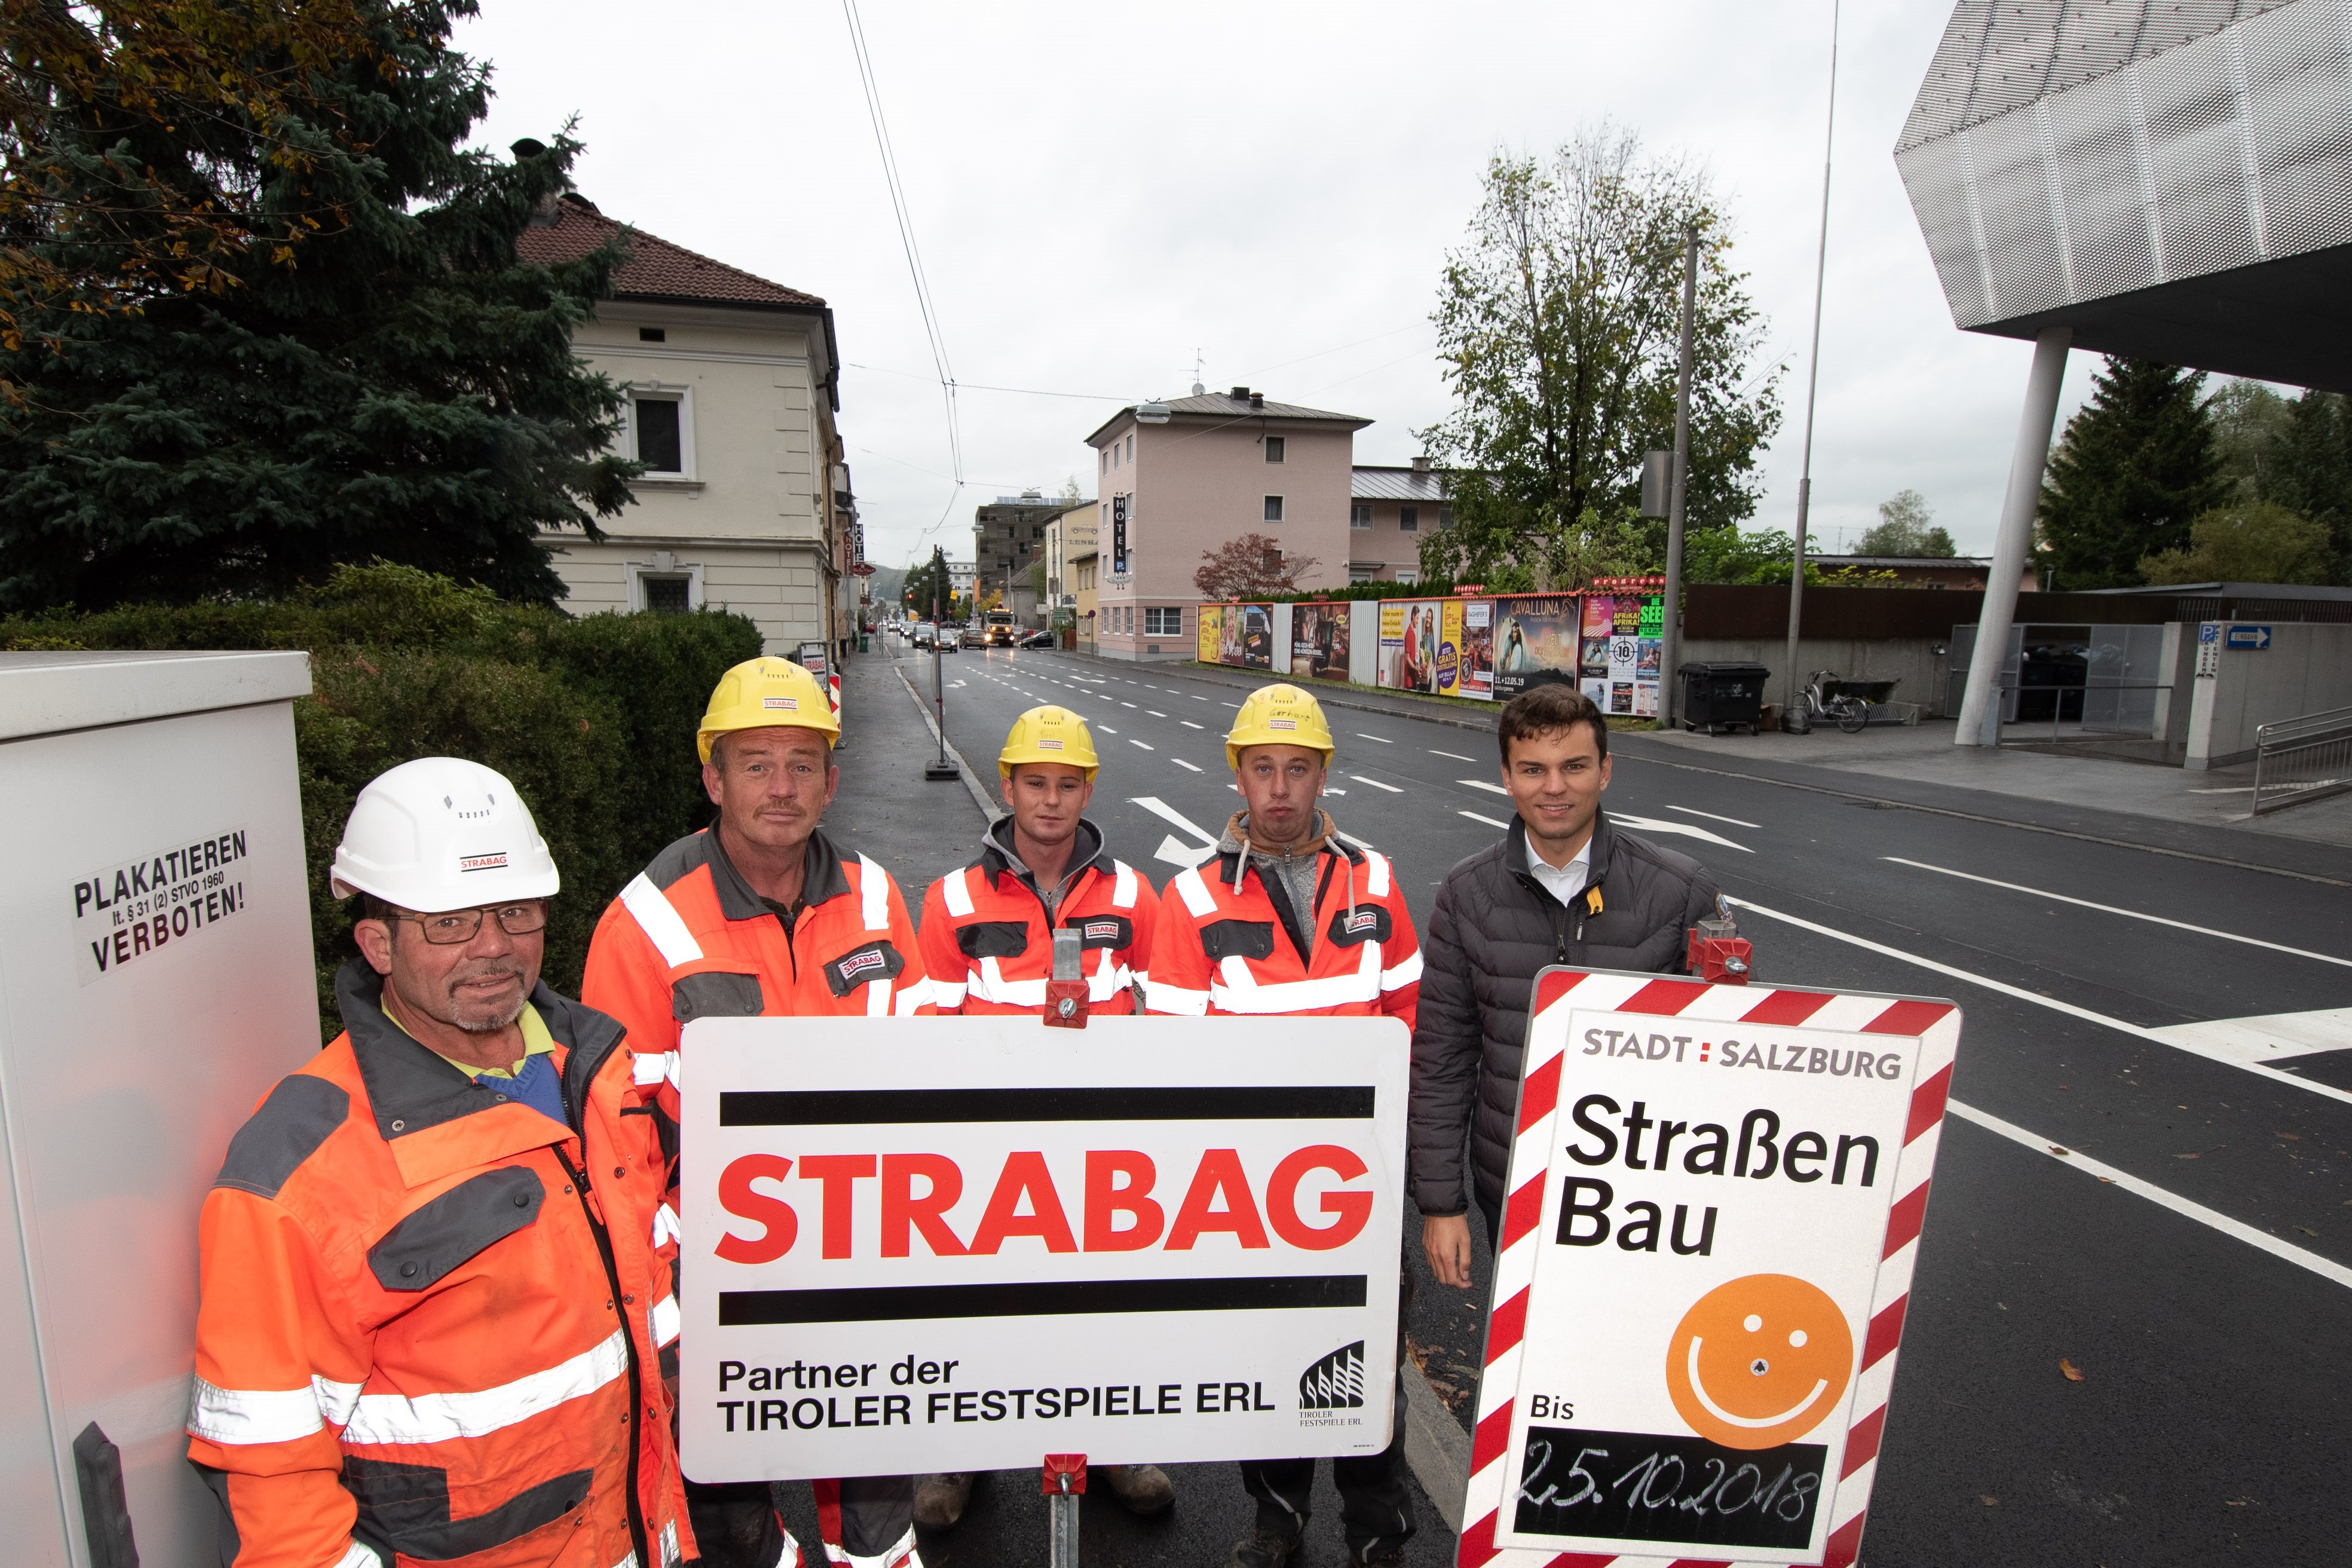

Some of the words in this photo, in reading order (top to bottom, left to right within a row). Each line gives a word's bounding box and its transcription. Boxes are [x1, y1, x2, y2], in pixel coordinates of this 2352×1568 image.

[855, 525, 863, 562] HOTE
[1116, 500, 1125, 557] HOTEL
[1510, 600, 1560, 615] CAVALLUNA
[1438, 652, 1456, 664] GRATIS
[1442, 647, 1451, 655] JETZT
[1544, 633, 1562, 645] WELT
[2212, 625, 2221, 672] PATIENTEN
[804, 660, 825, 670] STRABAG
[74, 829, 247, 918] PLAKATIEREN
[461, 856, 507, 869] STRABAG
[112, 911, 125, 926] lt.
[127, 905, 134, 922] §
[137, 899, 150, 917] 31
[154, 890, 168, 912] (2)
[172, 880, 199, 903] STVO
[201, 870, 225, 891] 1960
[91, 881, 244, 973] VERBOTEN!
[1088, 926, 1117, 935] STRABAG
[844, 956, 881, 973] STRABAG
[1582, 1028, 1692, 1062] STADT
[1719, 1040, 1902, 1080] SALZBURG
[1565, 1094, 1880, 1187] Straßen
[713, 1144, 1374, 1264] STRABAG
[1555, 1175, 1719, 1257] Bau
[719, 1360, 877, 1392] Partner
[890, 1353, 959, 1385] der
[716, 1394, 911, 1432] TIROLER
[927, 1385, 1182, 1423] FESTSPIELE
[1196, 1382, 1275, 1413] ERL
[1530, 1395, 1575, 1420] Bis
[1513, 1438, 1821, 1523] 25.10.2018
